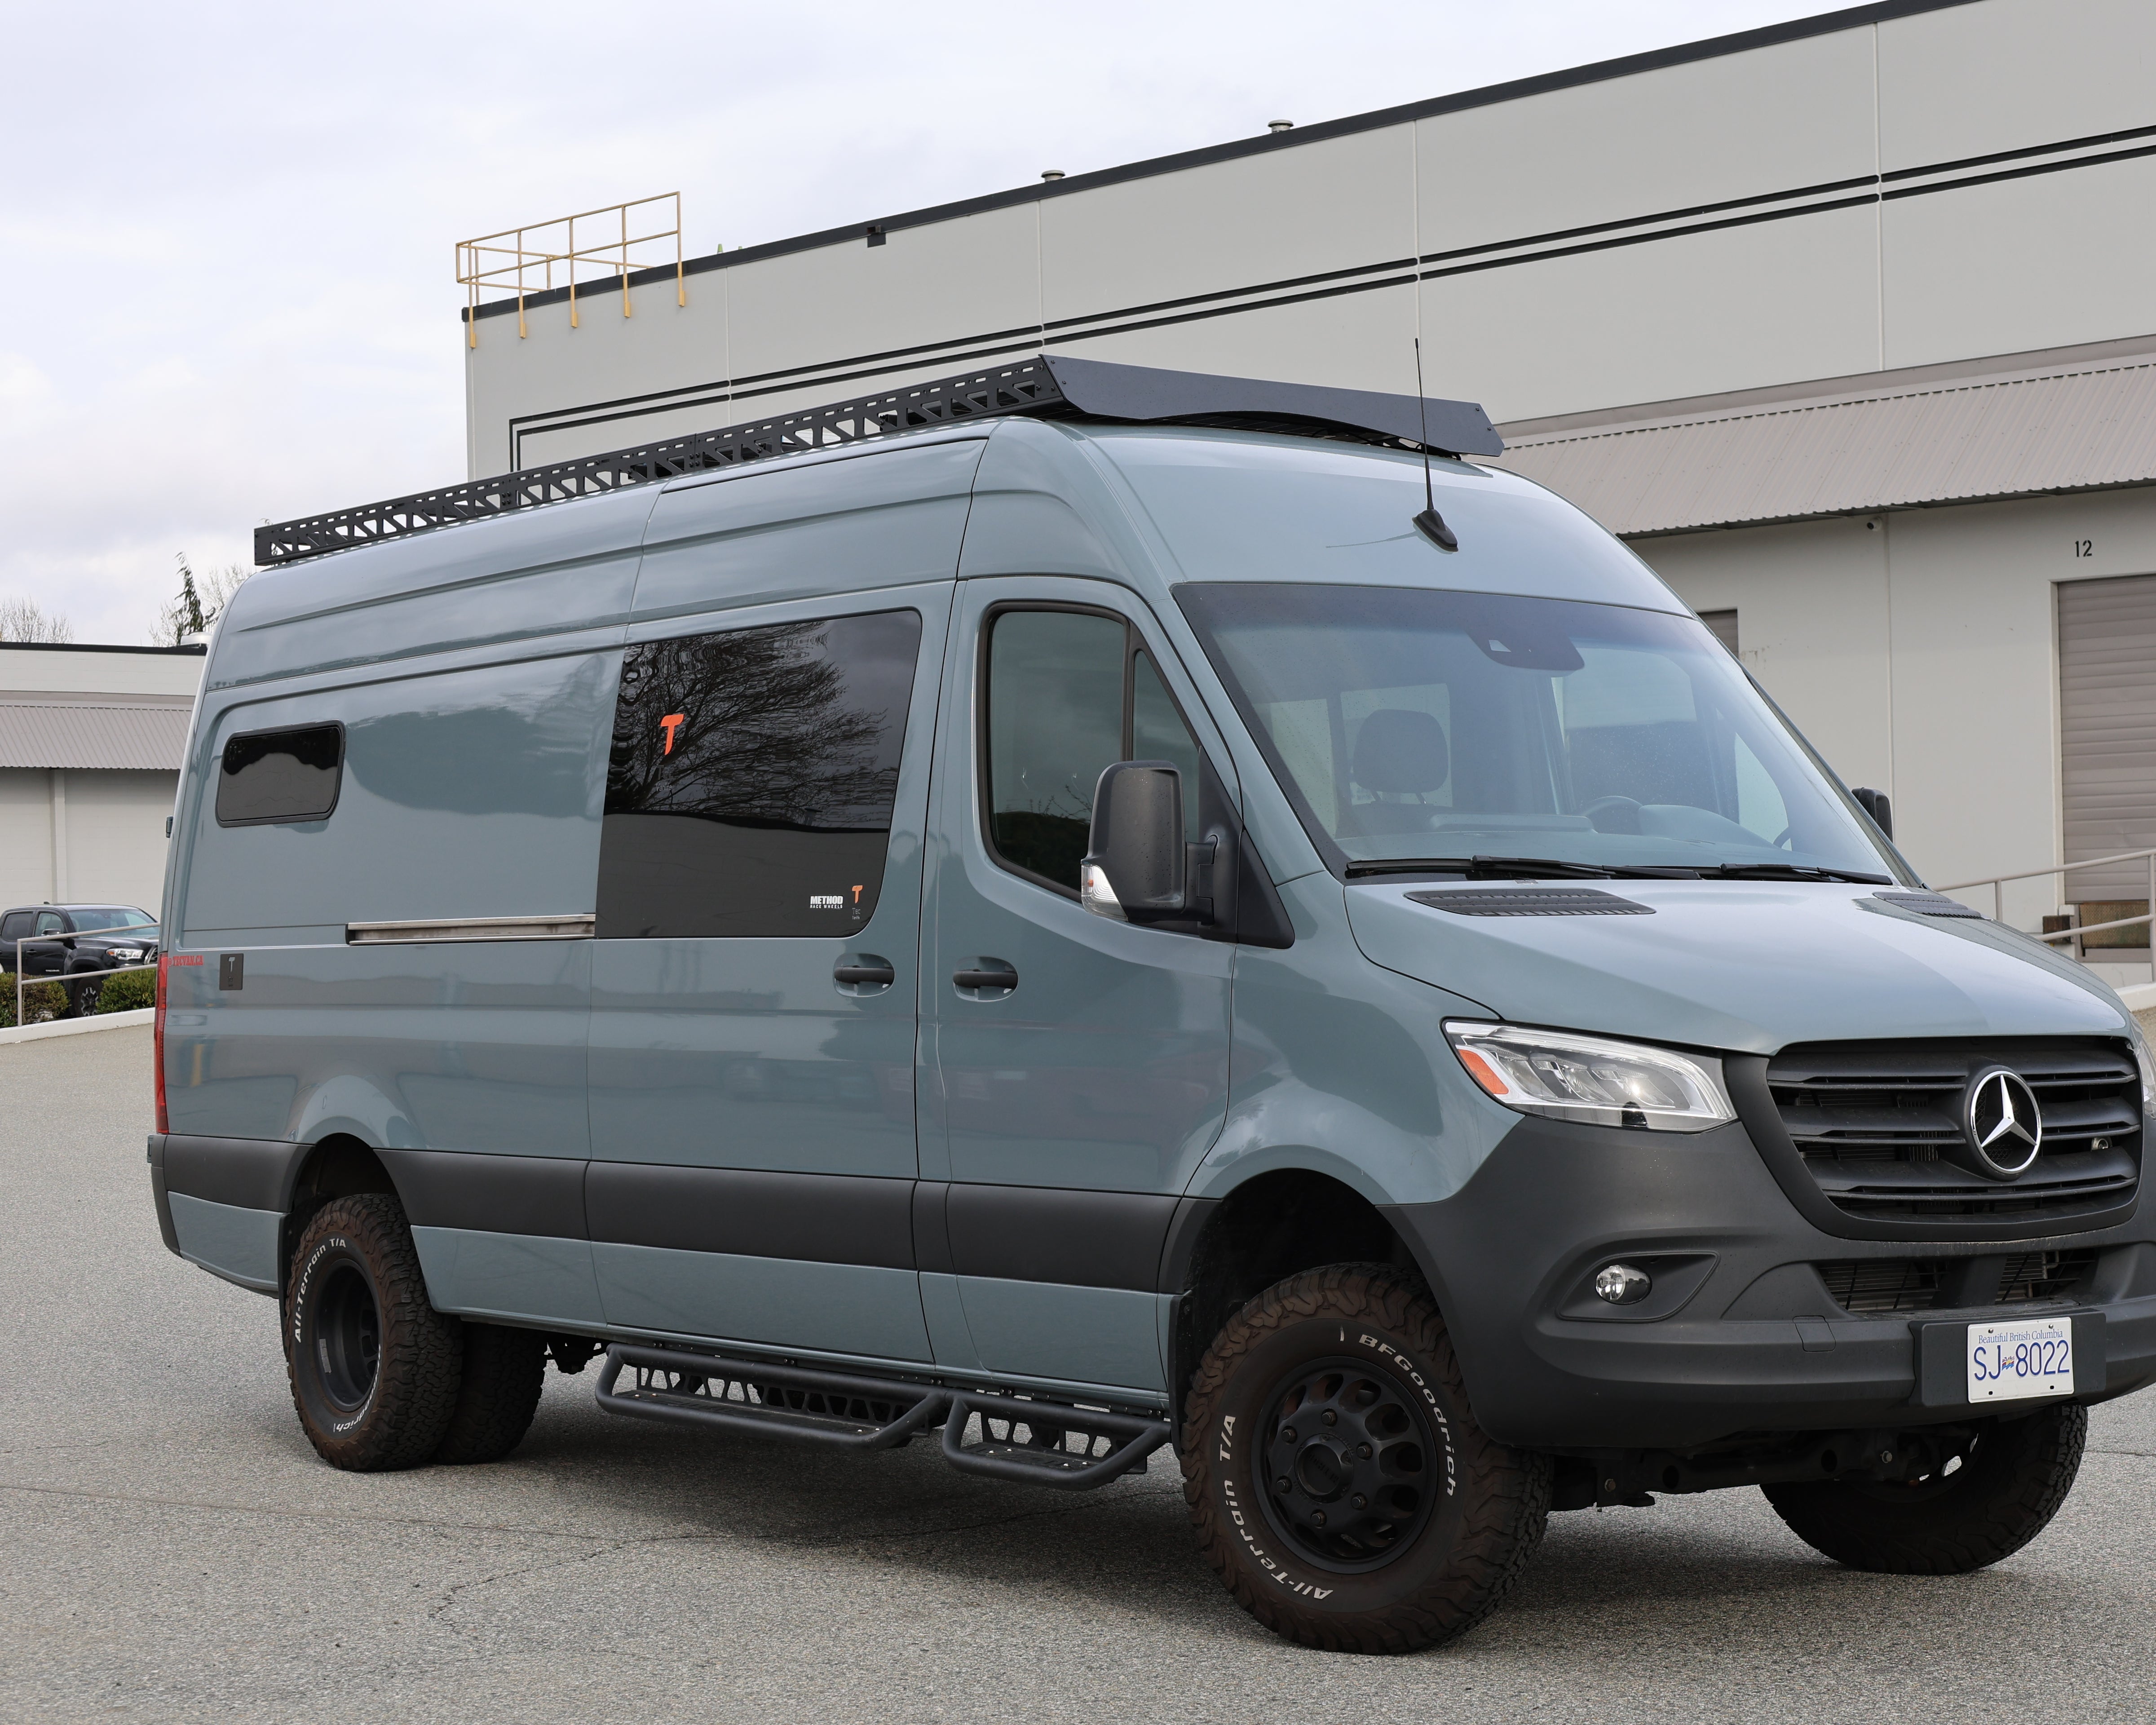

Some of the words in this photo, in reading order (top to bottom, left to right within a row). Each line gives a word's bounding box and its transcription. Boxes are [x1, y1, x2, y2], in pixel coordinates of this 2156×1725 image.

[2075, 540, 2092, 557] 12
[810, 896, 844, 904] METHOD
[295, 1245, 326, 1343] All-Terrain
[329, 1238, 346, 1248] T/A
[1979, 1332, 2008, 1344] Beautiful
[2010, 1331, 2030, 1341] British
[2032, 1329, 2063, 1340] Columbia
[1220, 1415, 1236, 1461] T/A
[1359, 1334, 1456, 1496] BFGoodrich
[1224, 1480, 1334, 1599] All-Terrain
